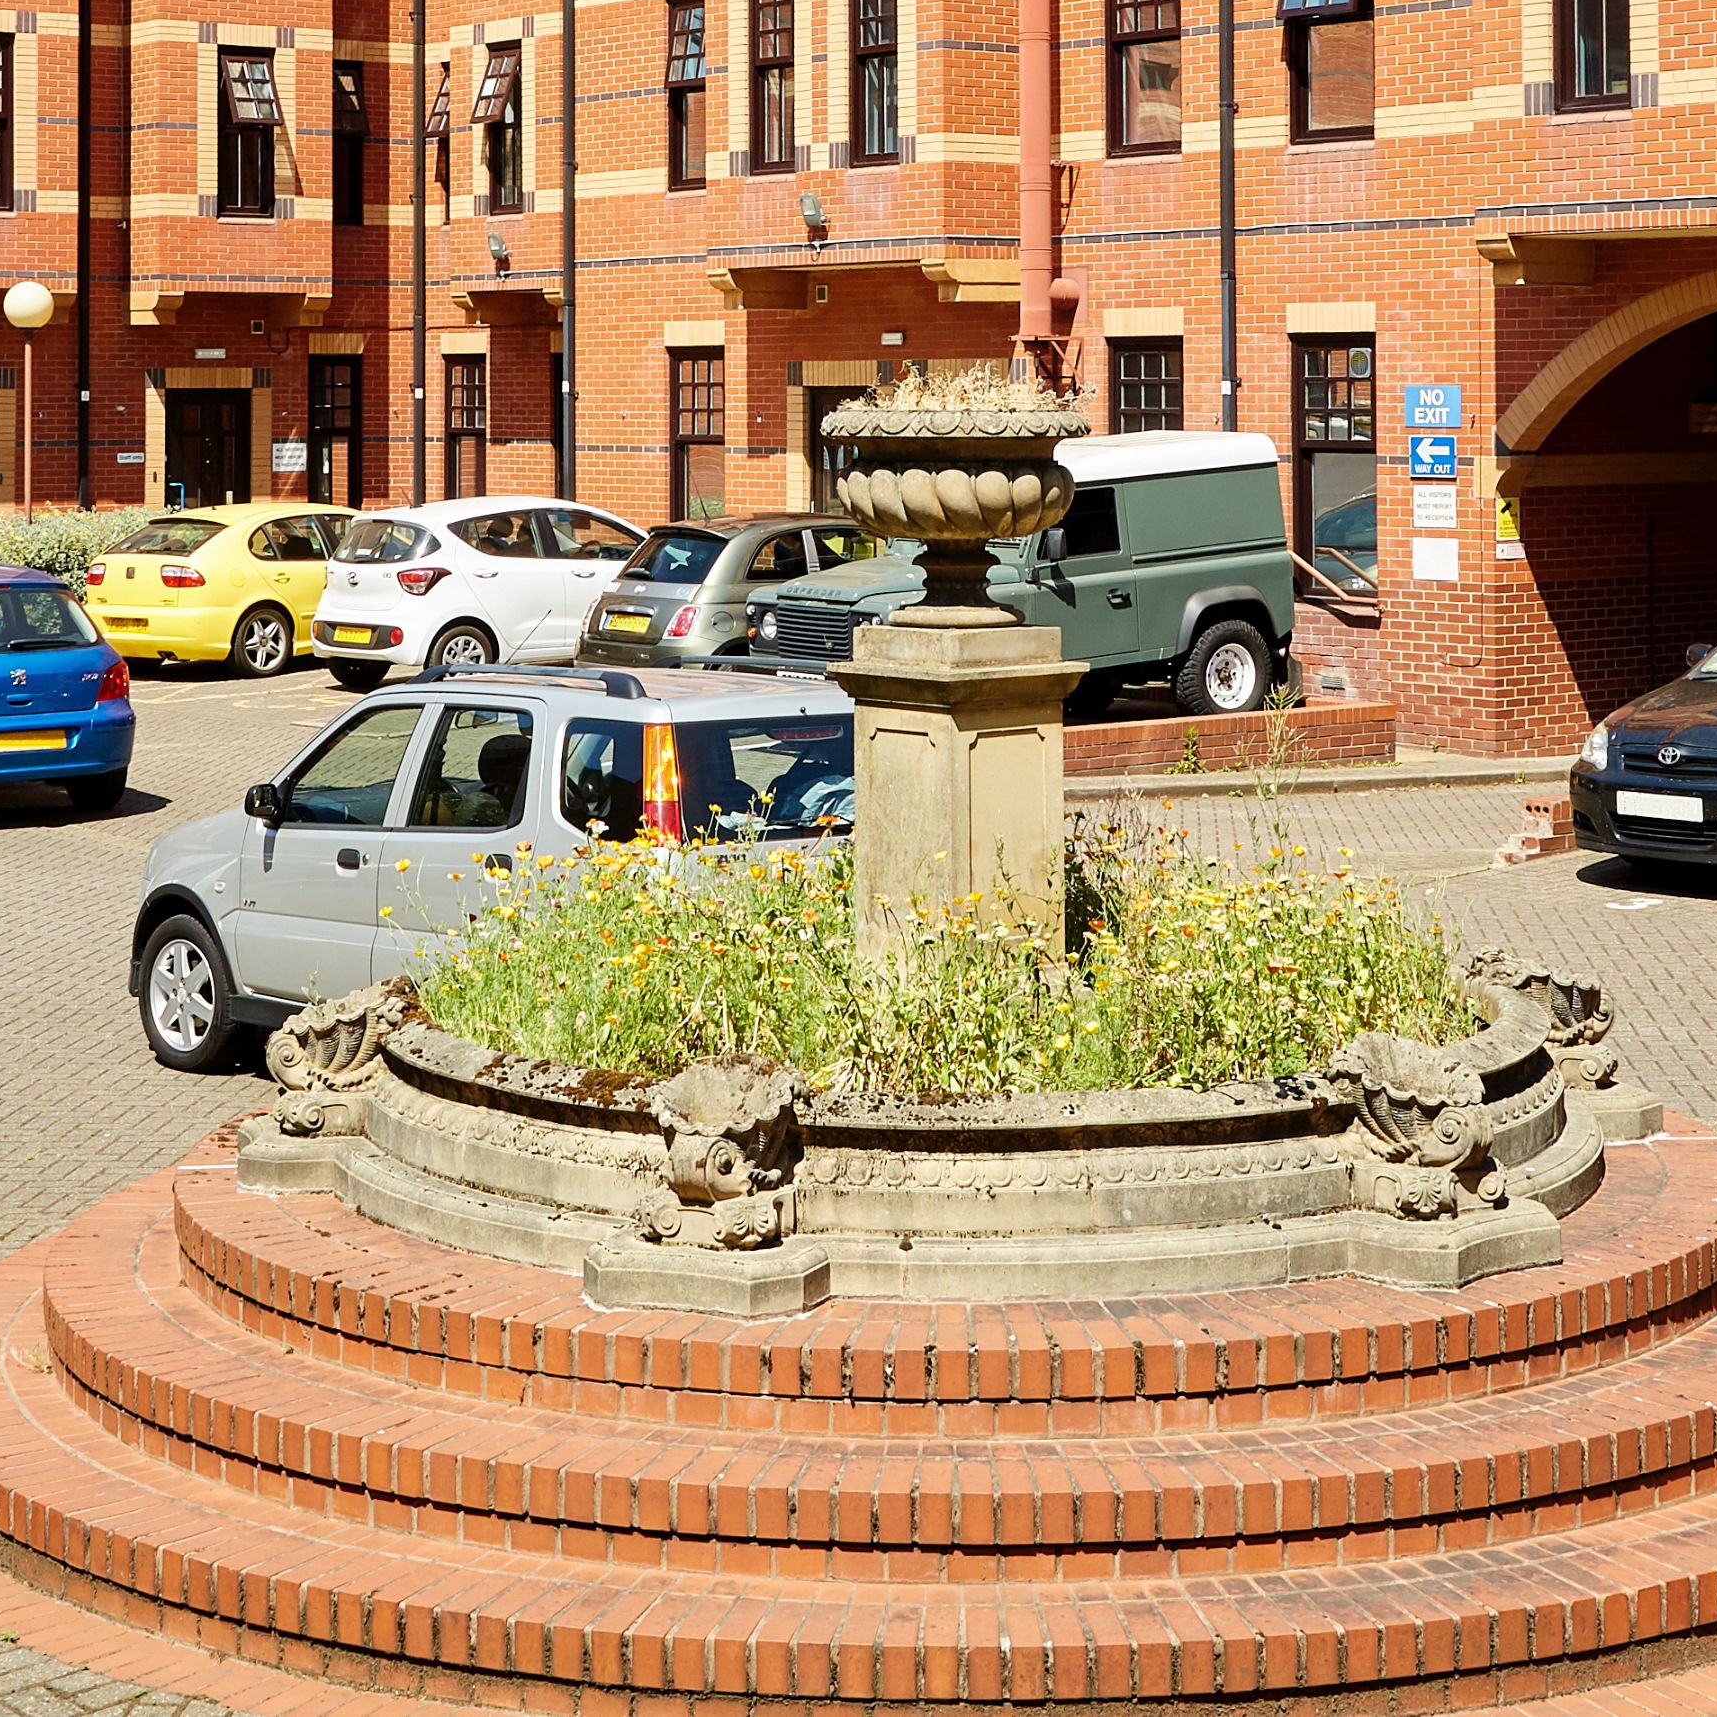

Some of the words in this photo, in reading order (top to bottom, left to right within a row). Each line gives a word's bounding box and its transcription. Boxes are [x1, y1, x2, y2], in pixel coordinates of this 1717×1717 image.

[1419, 389, 1445, 406] NO
[1414, 407, 1450, 424] EXIT
[1415, 463, 1433, 473] WAY
[1433, 463, 1452, 473] OUT
[786, 586, 842, 596] DEFENDER
[1605, 898, 1663, 910] 3
